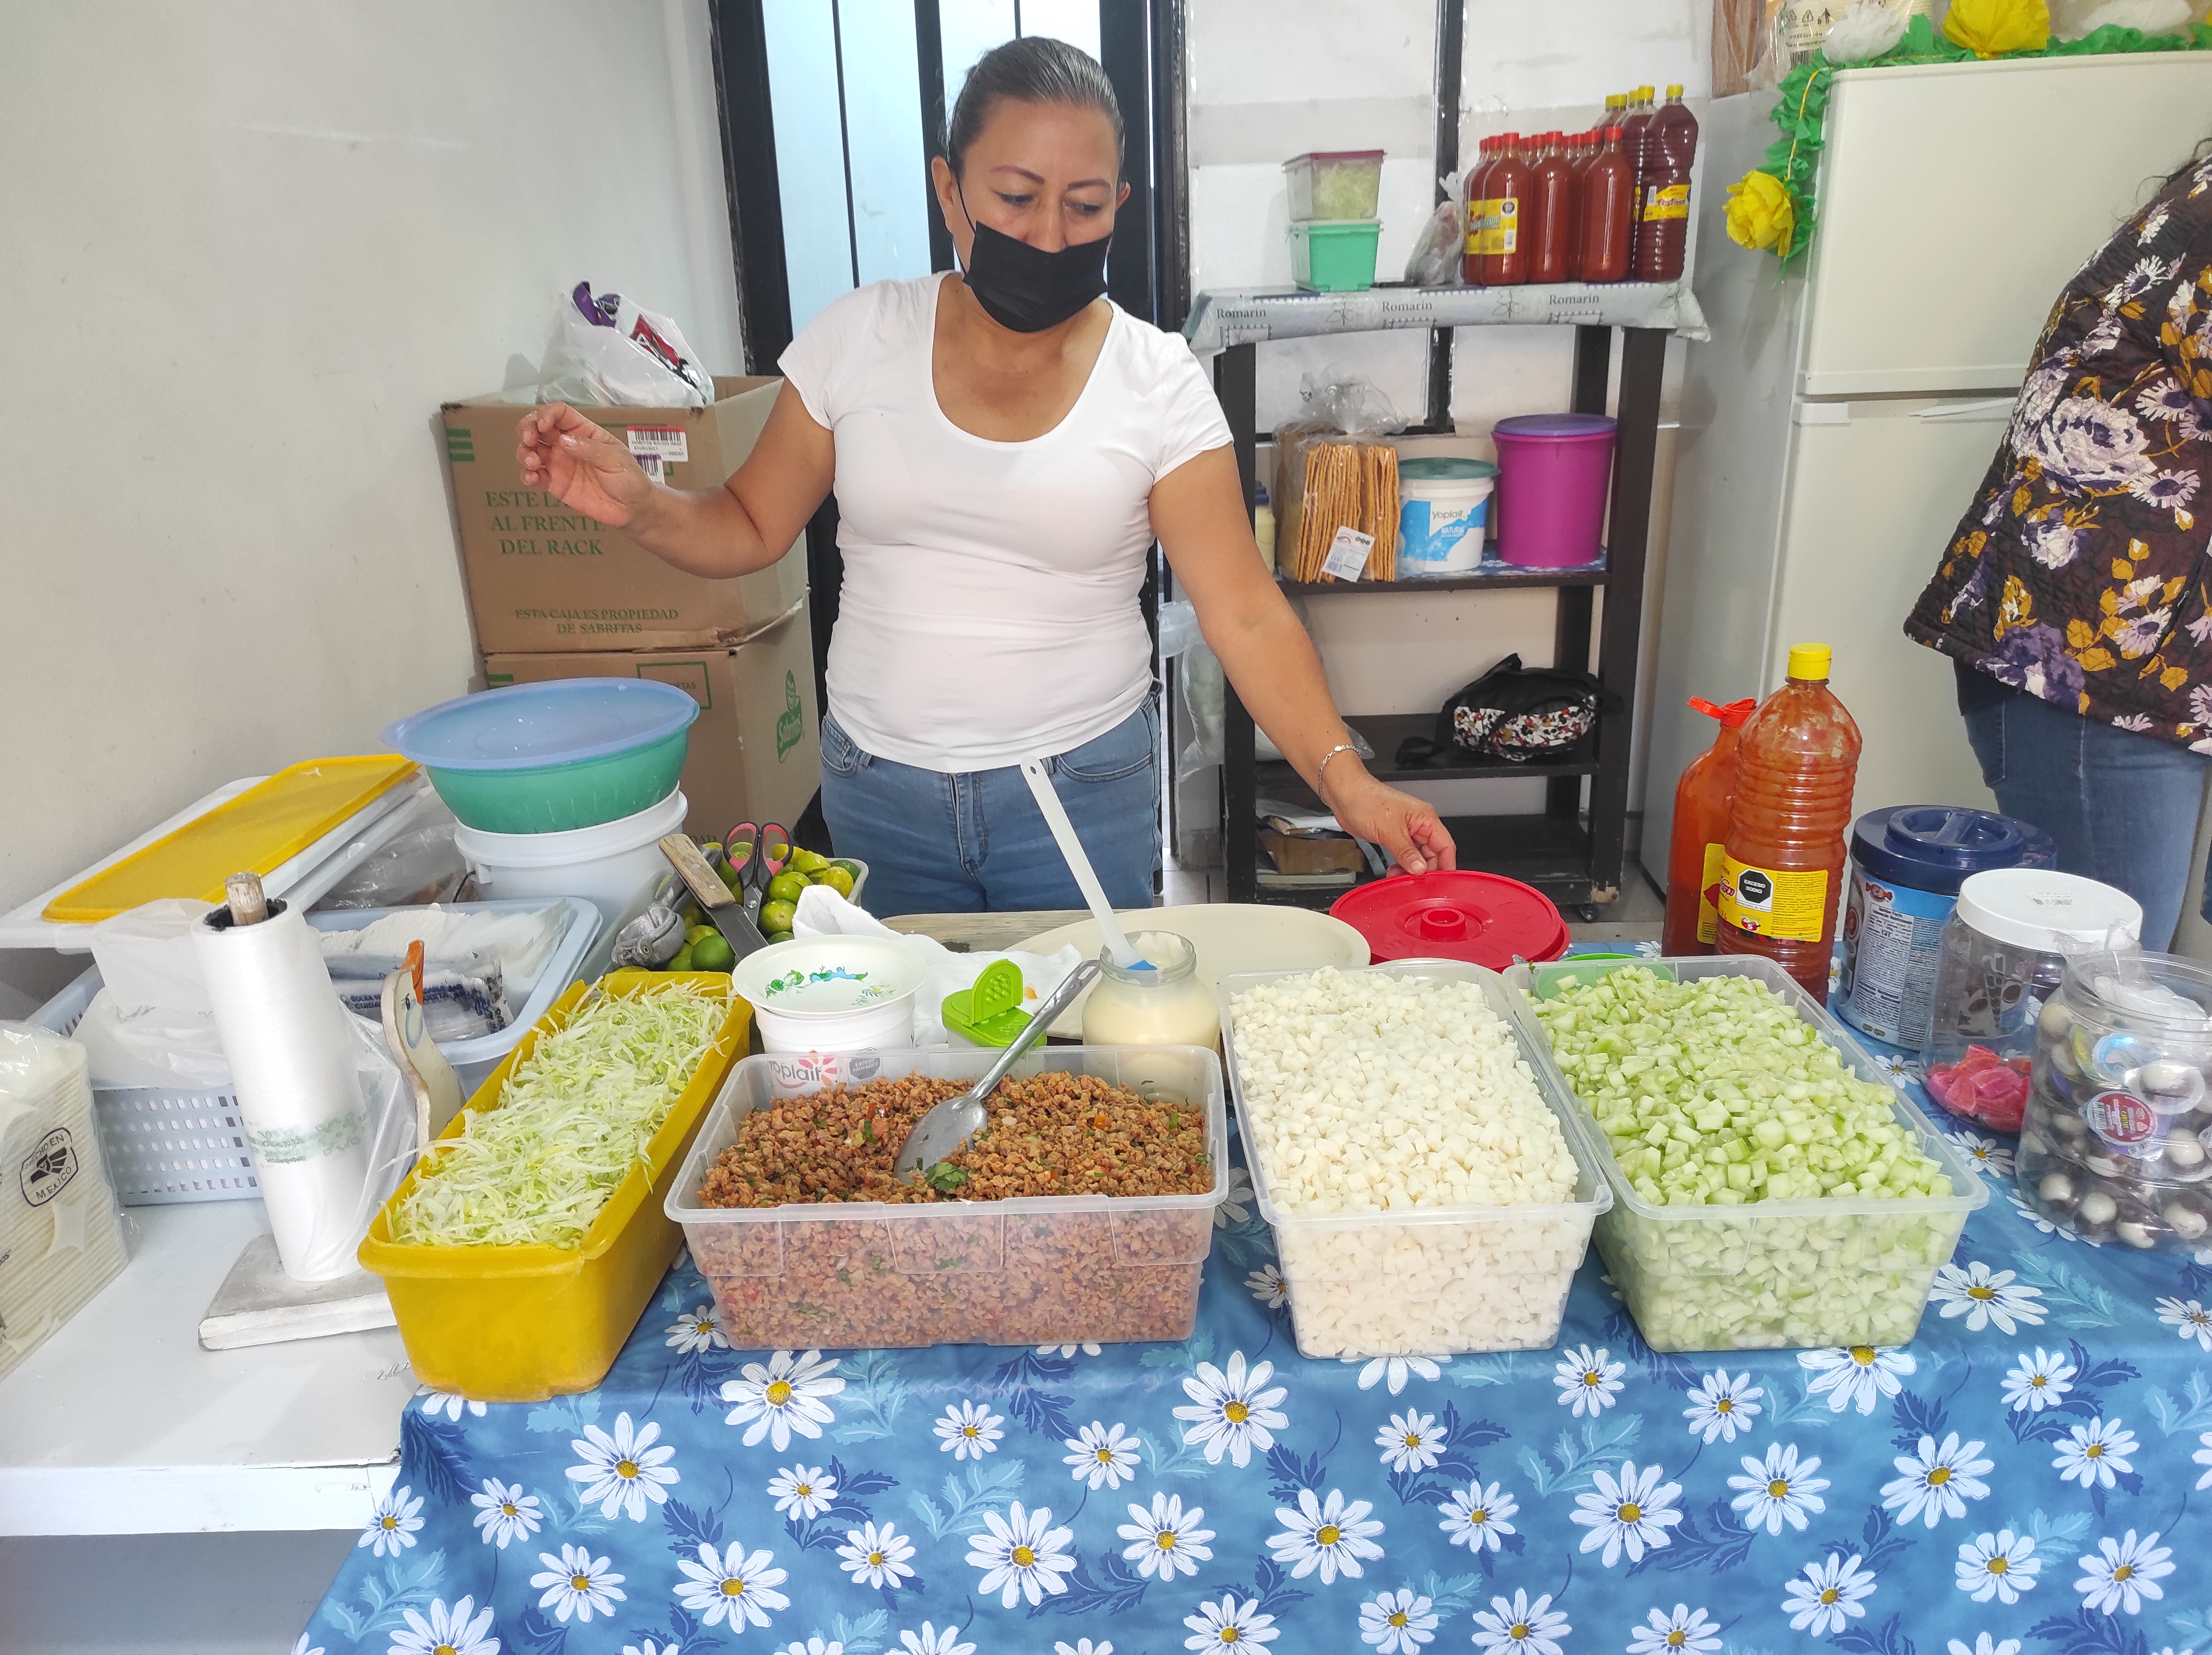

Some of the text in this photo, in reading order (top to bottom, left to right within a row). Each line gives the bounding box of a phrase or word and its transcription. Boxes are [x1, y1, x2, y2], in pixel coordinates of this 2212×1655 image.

[1549, 294, 1600, 305] Romarin
[1382, 301, 1433, 312] Romarin
[1216, 308, 1267, 319] Romarin
[485, 491, 538, 508] ESTE
[1432, 510, 1463, 520] Yoplait
[491, 516, 606, 532] AL FRENTE
[500, 539, 604, 555] DEL RACK
[515, 609, 679, 620] ESTA CAJA ES PROPIEDAD
[557, 623, 643, 634] DE SABRITAS
[1744, 879, 1766, 889] EXCESO
[1745, 886, 1763, 894] SODIO
[49, 1134, 65, 1146] EN
[35, 1166, 72, 1200] MEXICO
